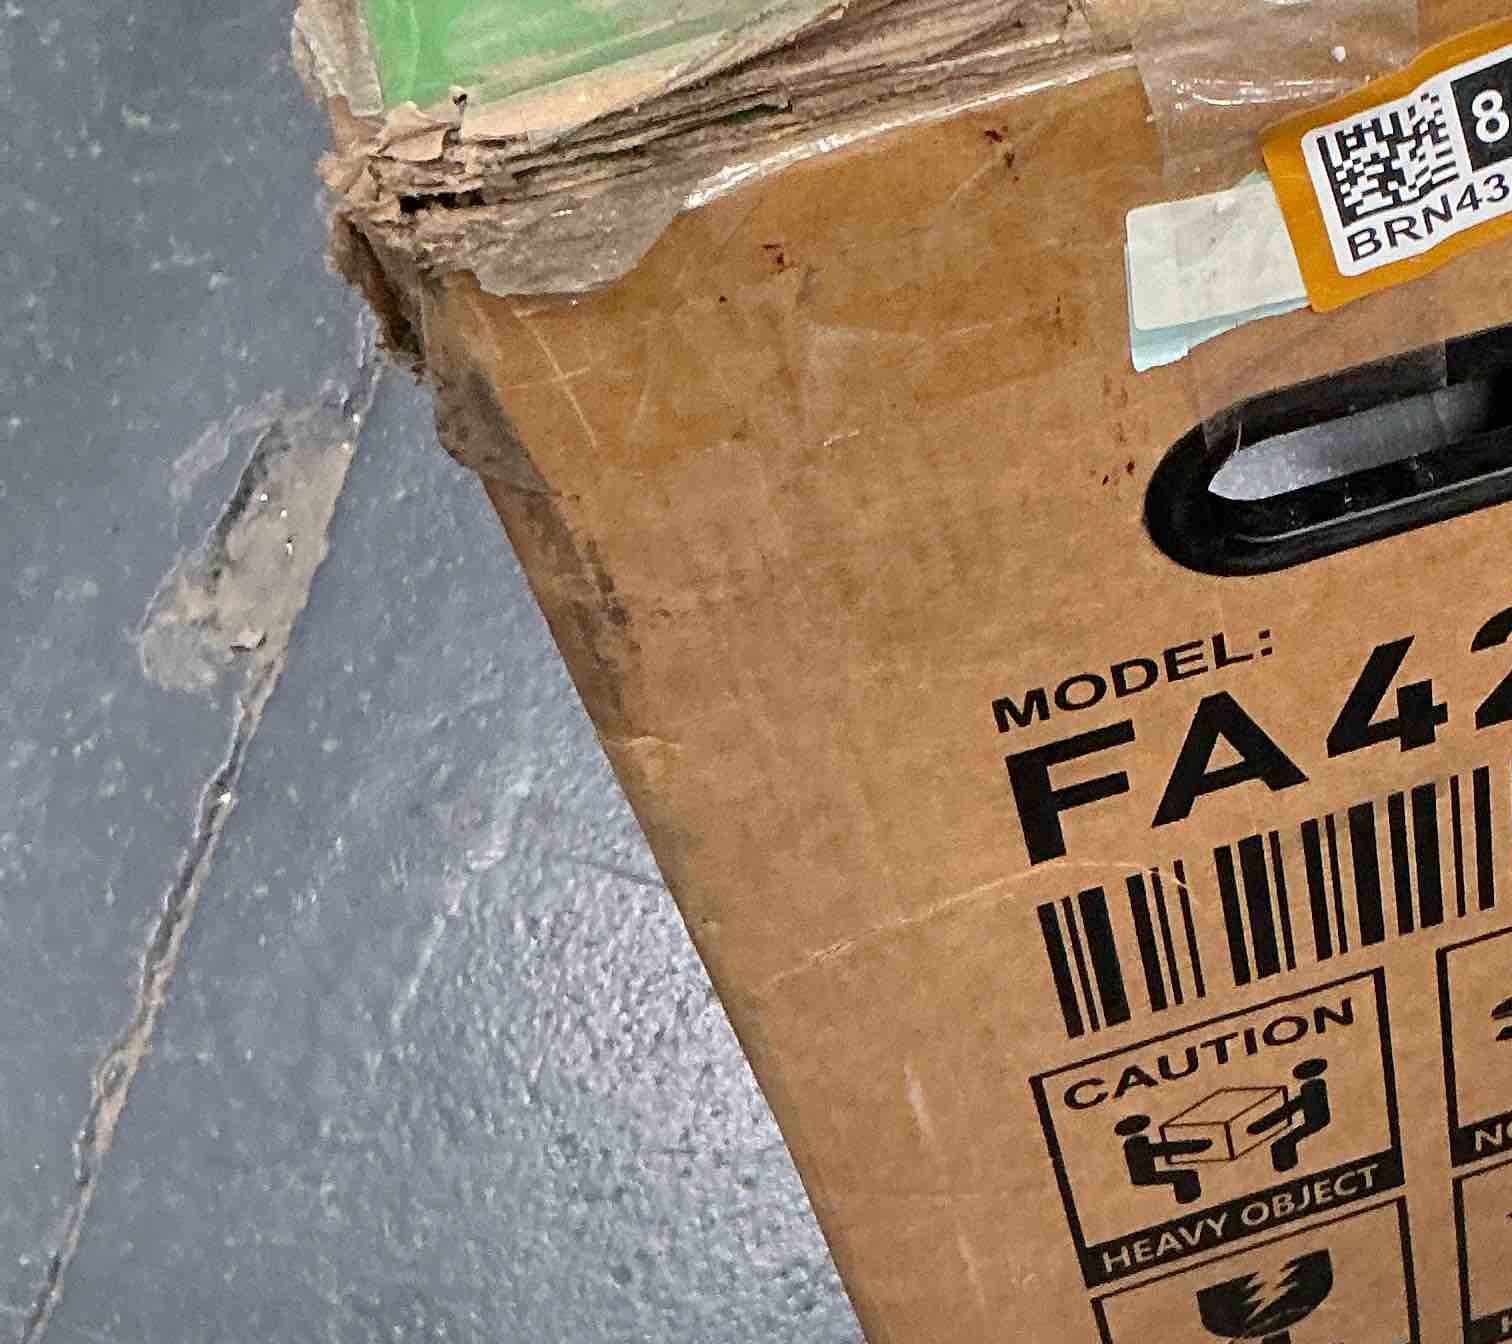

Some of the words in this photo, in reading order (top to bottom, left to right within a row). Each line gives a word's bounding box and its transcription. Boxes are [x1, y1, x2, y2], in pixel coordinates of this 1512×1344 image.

[990, 628, 1274, 734] MODEL:
[1063, 996, 1355, 1110] CAUTION
[1102, 1216, 1233, 1274] HEAVY
[1242, 1163, 1380, 1229] OBJECT
